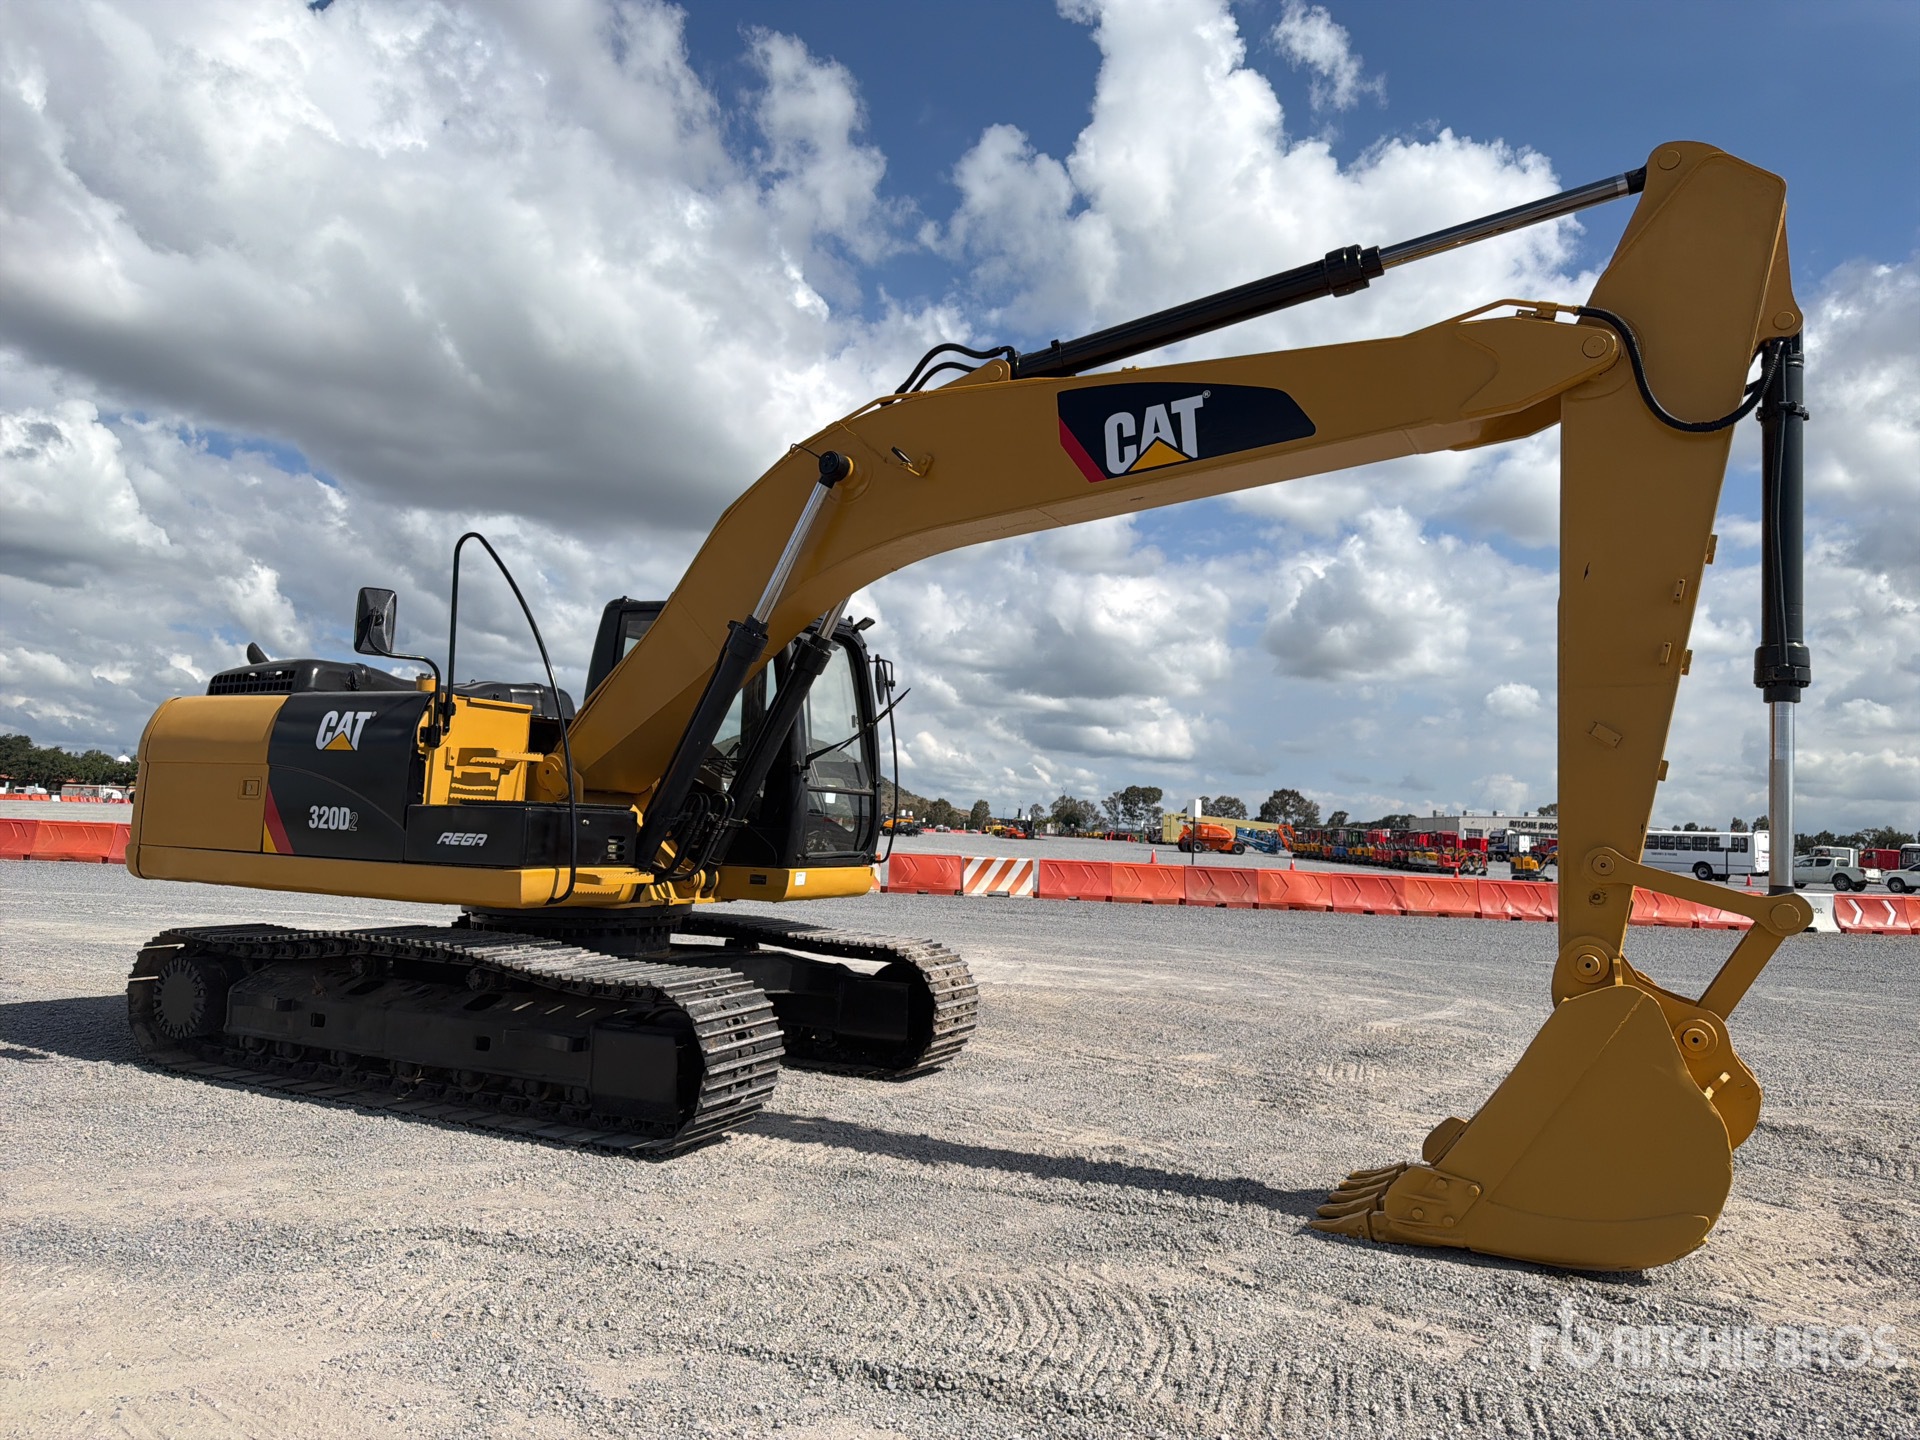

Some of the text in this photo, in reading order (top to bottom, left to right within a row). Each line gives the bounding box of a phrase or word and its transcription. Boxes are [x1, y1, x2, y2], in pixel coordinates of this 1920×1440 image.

[1104, 394, 1205, 475] CAT
[315, 710, 373, 752] CAT
[308, 805, 358, 832] 320D2
[1509, 820, 1537, 830] RITCHIE
[437, 831, 488, 847] REGA
